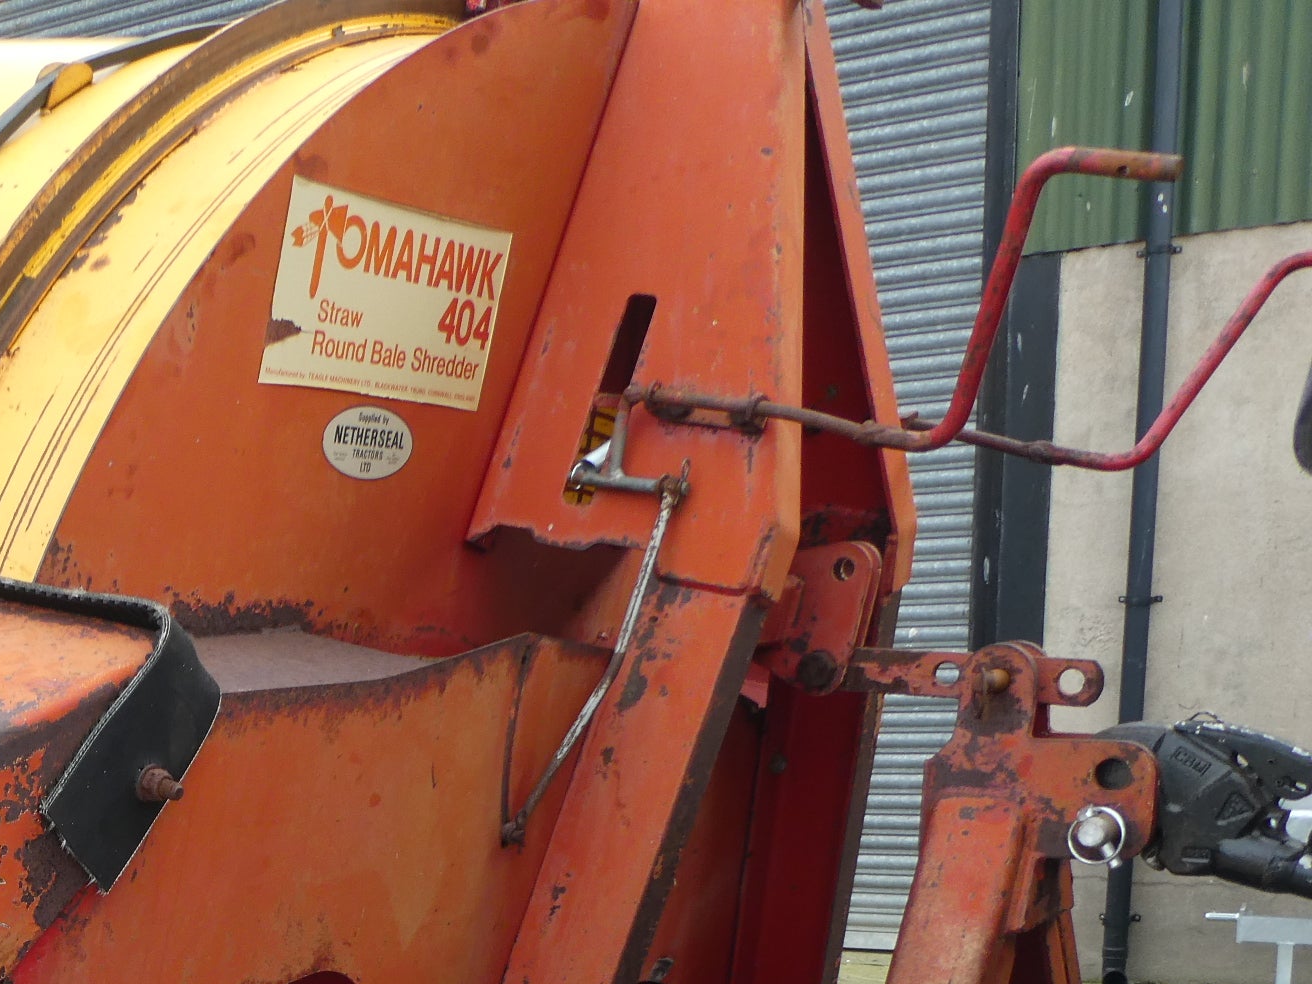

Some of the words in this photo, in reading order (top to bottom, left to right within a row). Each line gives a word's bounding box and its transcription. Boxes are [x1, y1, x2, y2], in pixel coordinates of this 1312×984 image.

[317, 299, 363, 328] Straw
[438, 298, 492, 350] 404
[311, 330, 367, 363] Round
[370, 340, 406, 369] Bale
[411, 347, 479, 381] Shredder
[359, 412, 381, 424] Supplied
[382, 413, 389, 425] by
[334, 425, 404, 450] NETHERSEAL
[352, 449, 383, 460] TRACTORS
[359, 461, 372, 473] LTD
